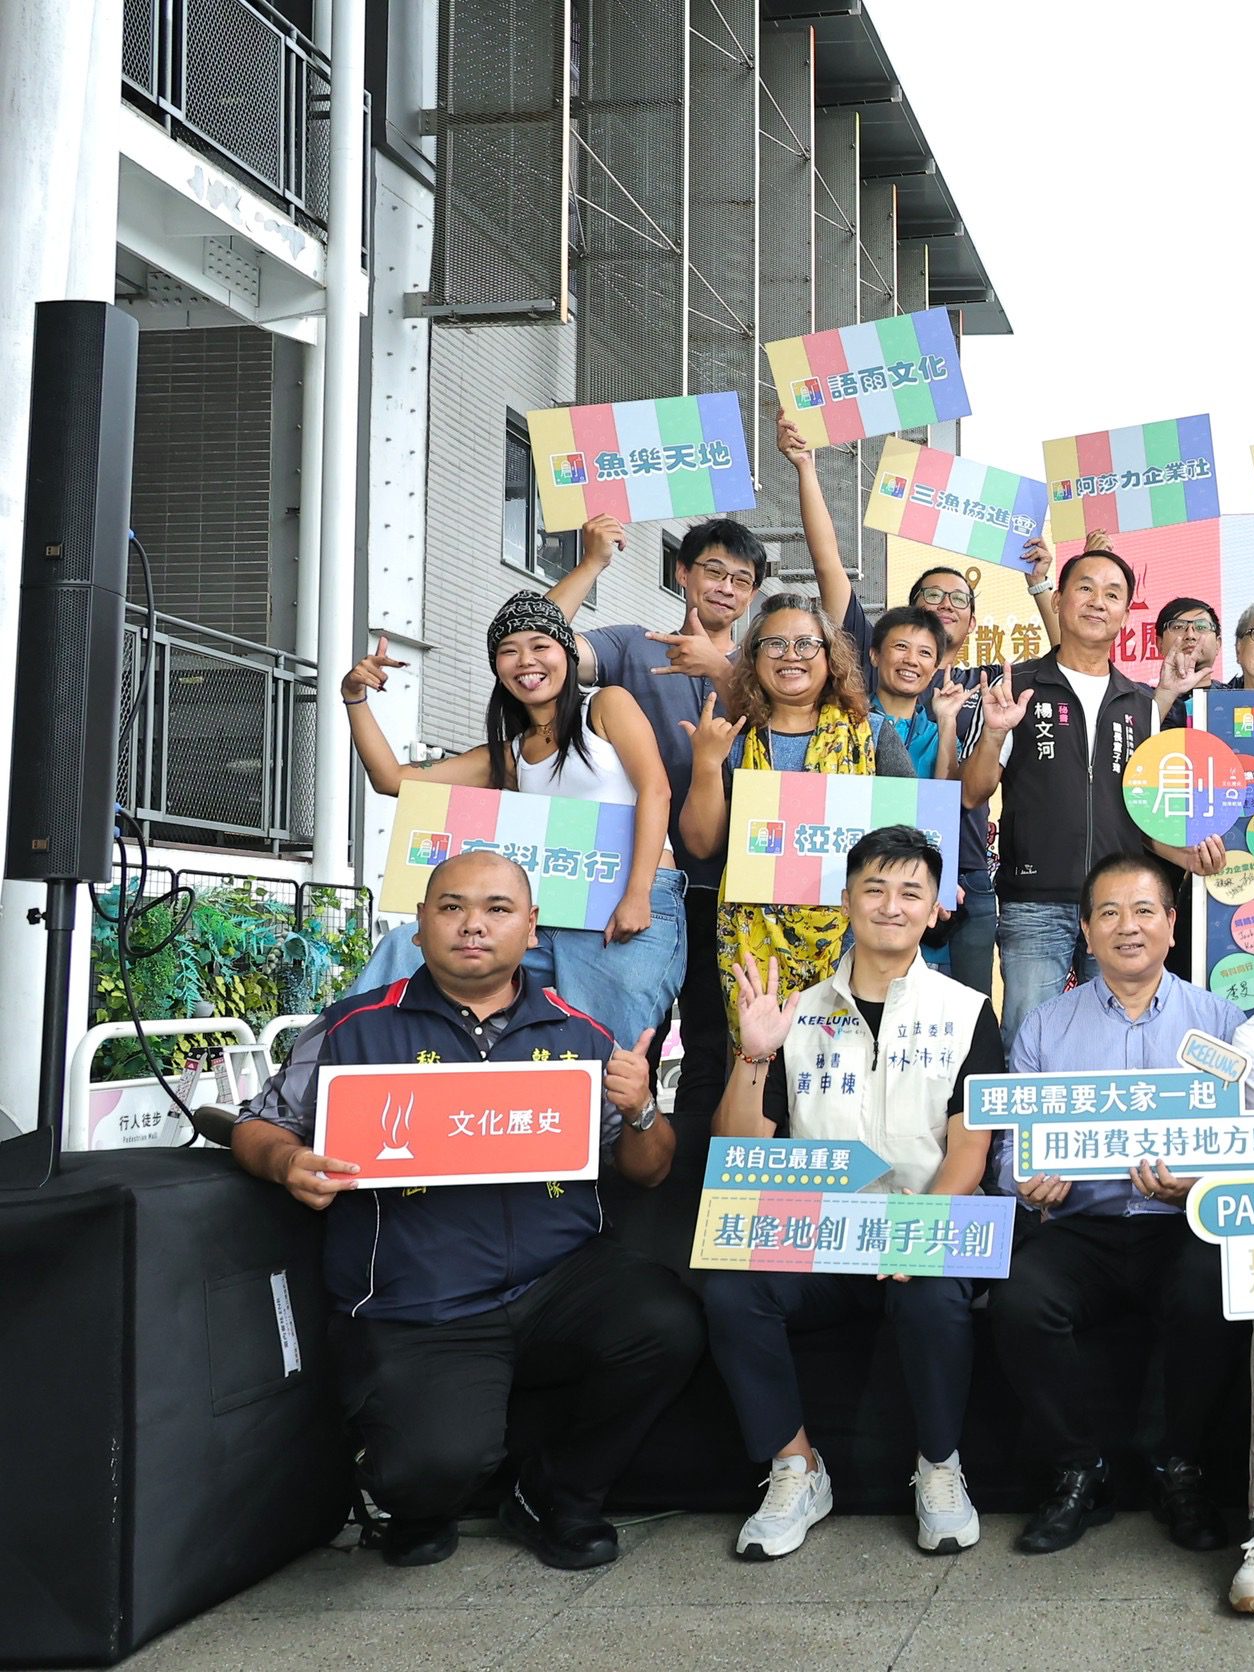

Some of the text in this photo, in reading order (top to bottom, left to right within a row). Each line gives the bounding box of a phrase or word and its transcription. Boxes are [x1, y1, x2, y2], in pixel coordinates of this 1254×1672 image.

[828, 354, 948, 400] 語雨文化
[595, 440, 732, 480] 魚樂天地
[1075, 457, 1211, 497] 阿莎力企業社
[910, 484, 1036, 536] 三漁協進會
[954, 624, 1041, 668] 散策
[1034, 702, 1055, 760] 楊文河
[797, 1015, 860, 1026] KEELUNG
[898, 1022, 954, 1038] 立法委員
[816, 1053, 841, 1068] 秘書
[1187, 1039, 1240, 1078] KEELUNG
[797, 1073, 856, 1094] 黃申棟
[981, 1080, 1217, 1116] 理想需要大家一起
[447, 1107, 562, 1138] 文化歷史
[725, 1145, 851, 1171] 找自己最重要
[713, 1213, 994, 1258] 基隆地創 攜手共創
